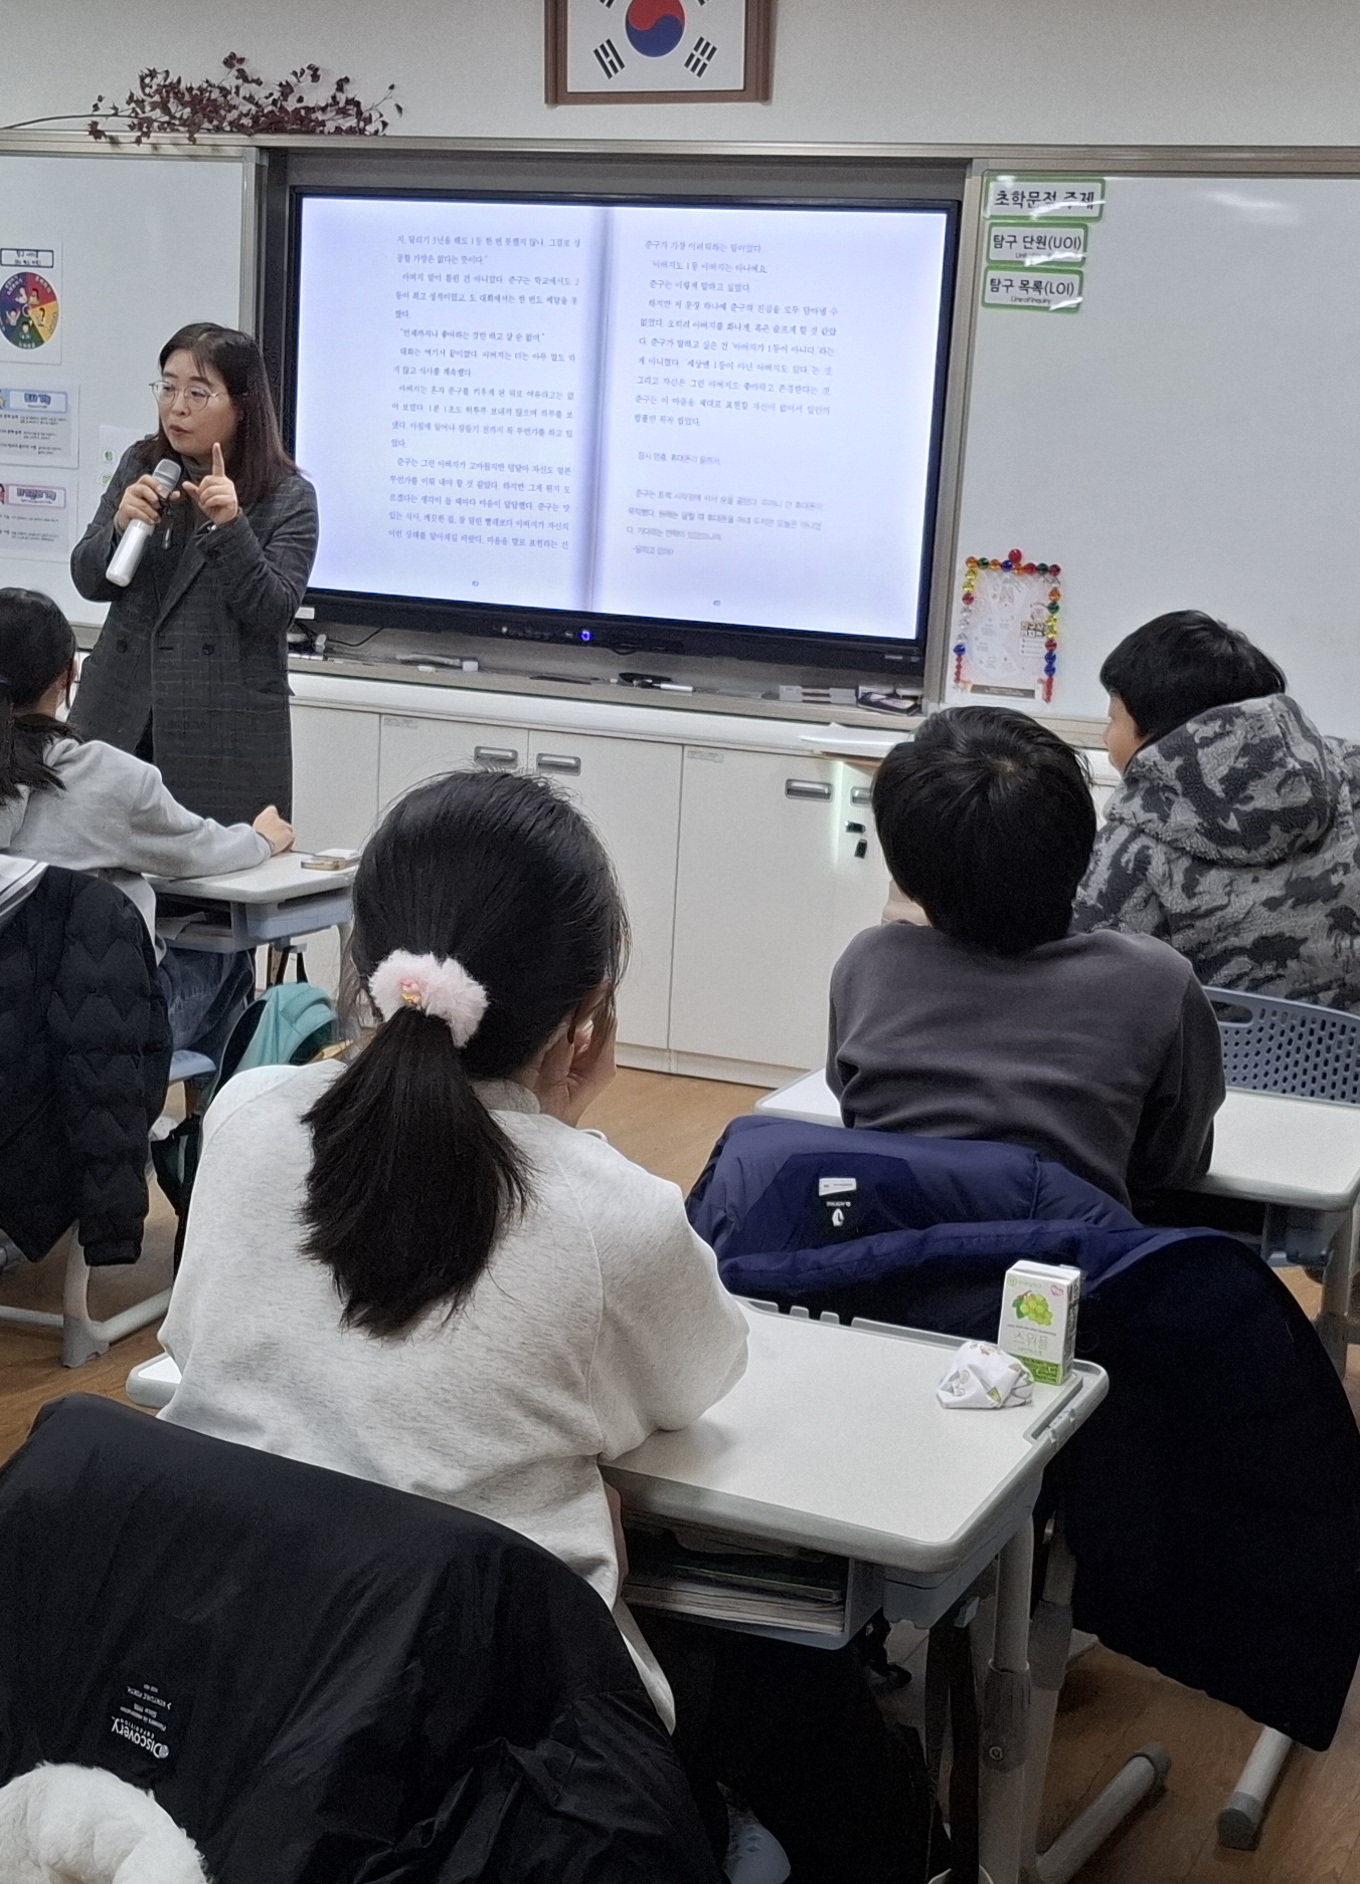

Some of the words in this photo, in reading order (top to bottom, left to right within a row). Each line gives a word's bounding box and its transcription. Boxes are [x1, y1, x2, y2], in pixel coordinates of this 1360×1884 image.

[994, 190, 1056, 209] 초학문적
[1064, 191, 1094, 209] 주제
[993, 234, 1017, 249] 탐구
[1023, 235, 1081, 250] 단원(UOI)
[990, 278, 1014, 293] 탐구
[1019, 280, 1074, 297] 목록(LOI)
